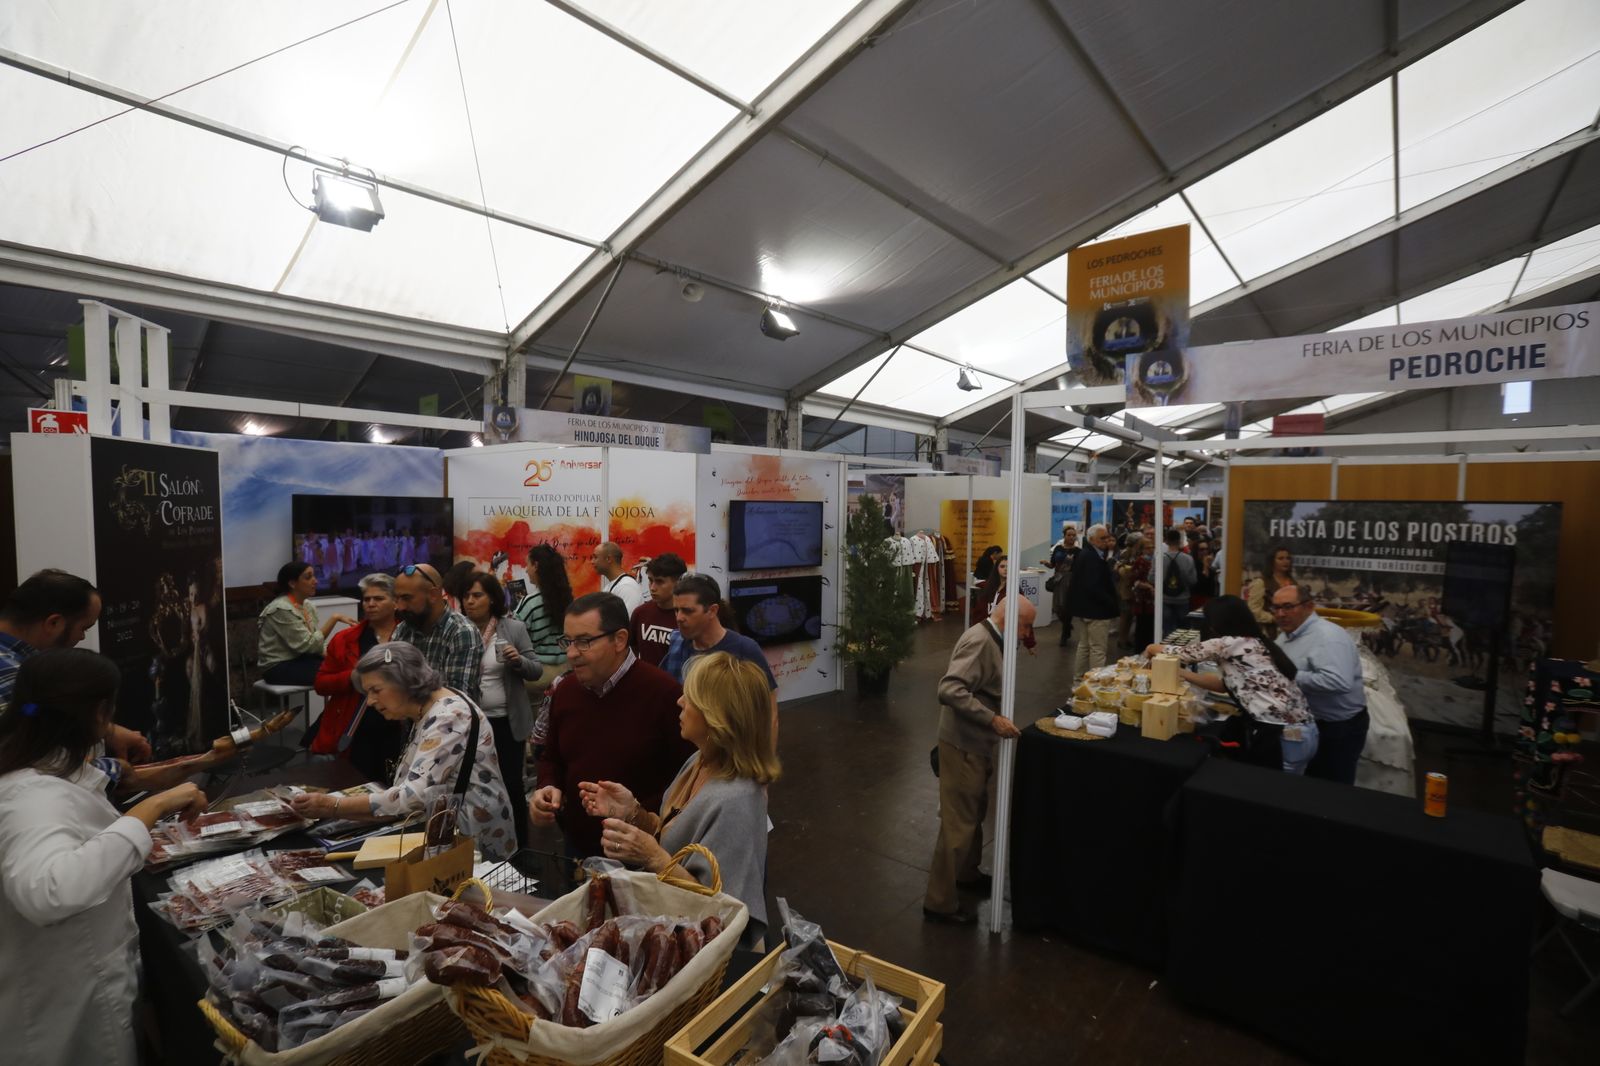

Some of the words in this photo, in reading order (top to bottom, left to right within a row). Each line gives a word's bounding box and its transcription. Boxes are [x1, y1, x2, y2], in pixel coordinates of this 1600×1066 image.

[1087, 258, 1104, 270] LOS
[1106, 245, 1164, 266] PEDROCHES
[1090, 273, 1122, 289] FERIA
[1122, 270, 1138, 283] DE
[1141, 264, 1164, 280] LOS
[1089, 277, 1165, 301] MUNICIPIOS
[1302, 337, 1352, 358] FERIA
[1358, 334, 1385, 352] DE
[1391, 328, 1432, 349] LOS
[1438, 310, 1589, 343] MUNICIPIOS
[1390, 343, 1547, 381] PEDROCHE
[567, 417, 587, 428] FERIA
[587, 419, 597, 428] DE
[598, 420, 611, 430] LOS
[612, 422, 649, 433] MUNICIPIOS
[574, 430, 616, 445] HINOJOSA
[618, 432, 632, 446] DEL
[635, 433, 660, 448] DUQUE
[559, 459, 603, 470] Aniversar
[530, 493, 562, 503] TEATRO
[564, 493, 602, 503] POPULAR
[483, 505, 496, 516] LA
[498, 505, 552, 519] VAQUERA
[556, 505, 571, 517] DE
[576, 505, 591, 517] LA
[593, 506, 656, 519] FNOJOSA
[1269, 518, 1327, 539] FIESTA
[1333, 520, 1356, 540] DE
[1363, 521, 1400, 542] LOS
[1407, 521, 1518, 547] PIOSTROS
[1358, 546, 1370, 554] de
[1373, 546, 1434, 558] SEPTIEMBRE
[641, 623, 674, 646] VANS
